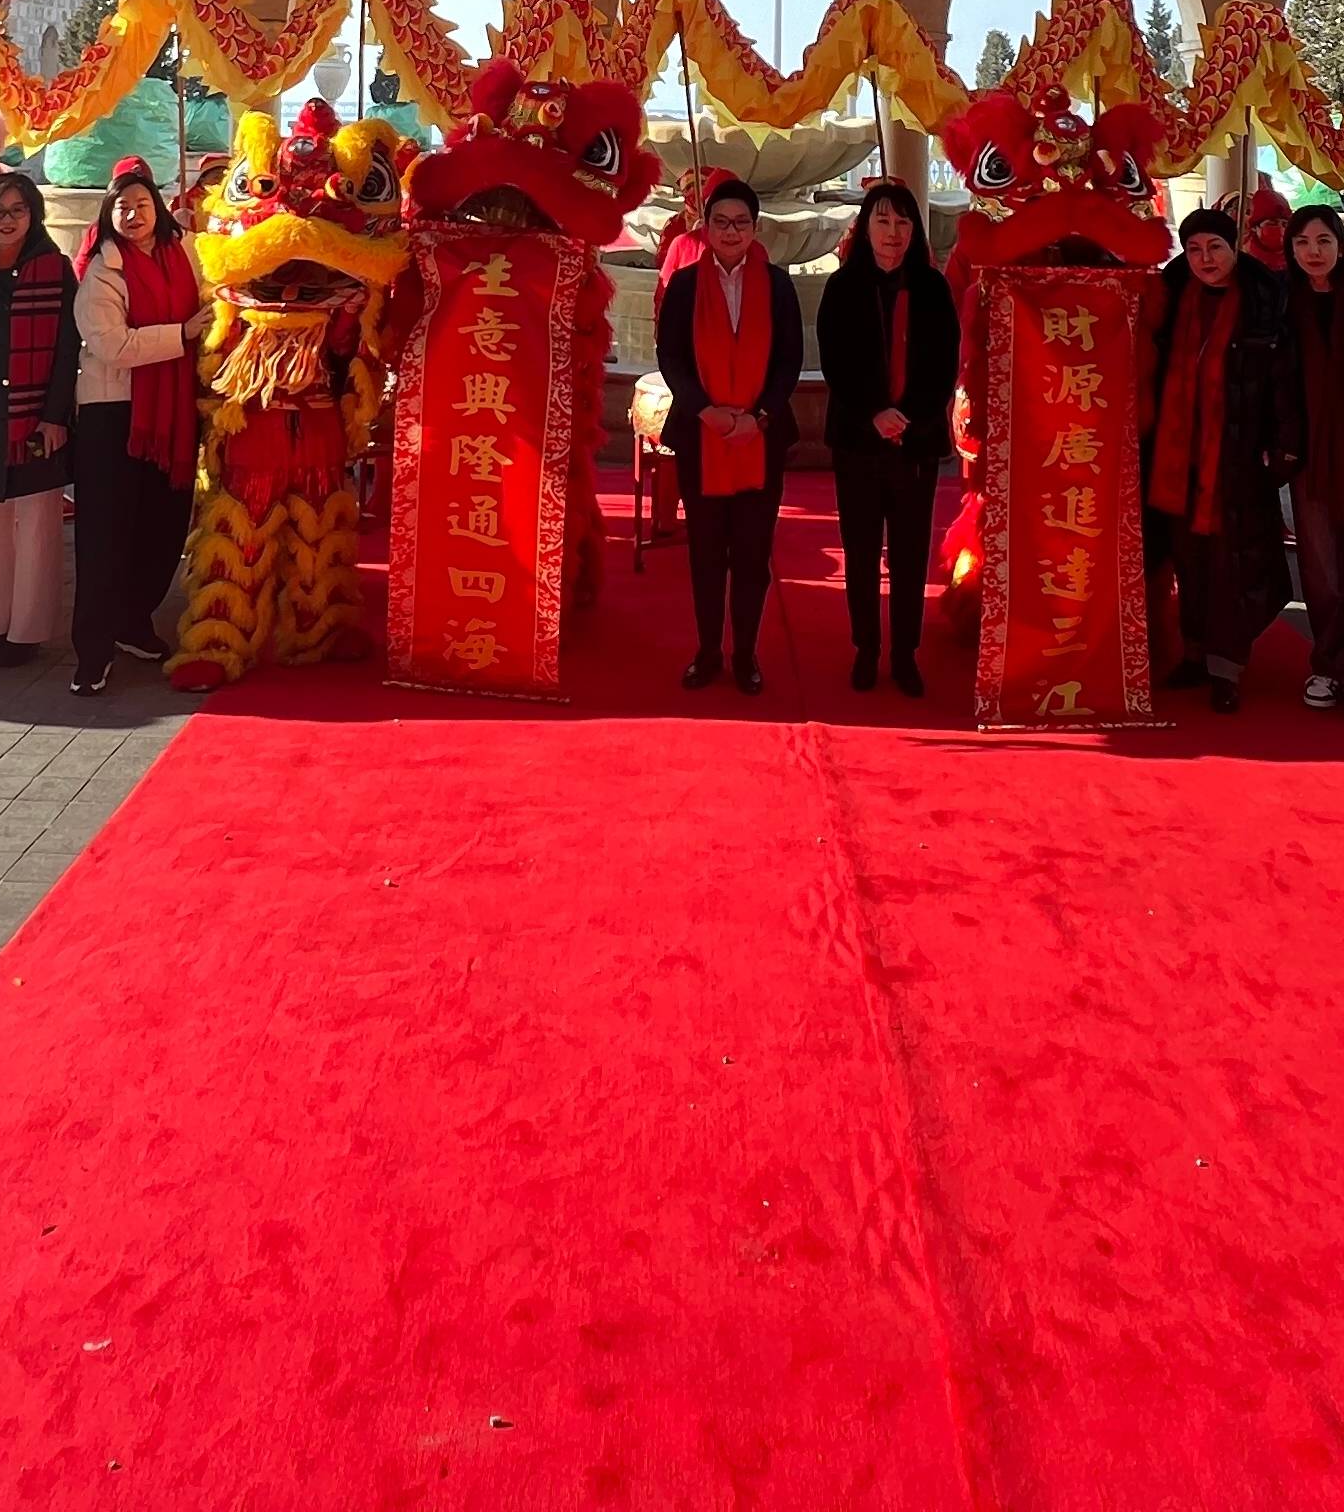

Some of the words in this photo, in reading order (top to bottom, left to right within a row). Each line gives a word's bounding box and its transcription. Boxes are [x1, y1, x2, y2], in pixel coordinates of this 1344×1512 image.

[442, 254, 519, 670] 生意興隆通四海
[1032, 305, 1108, 718] 財源廣進達三江
